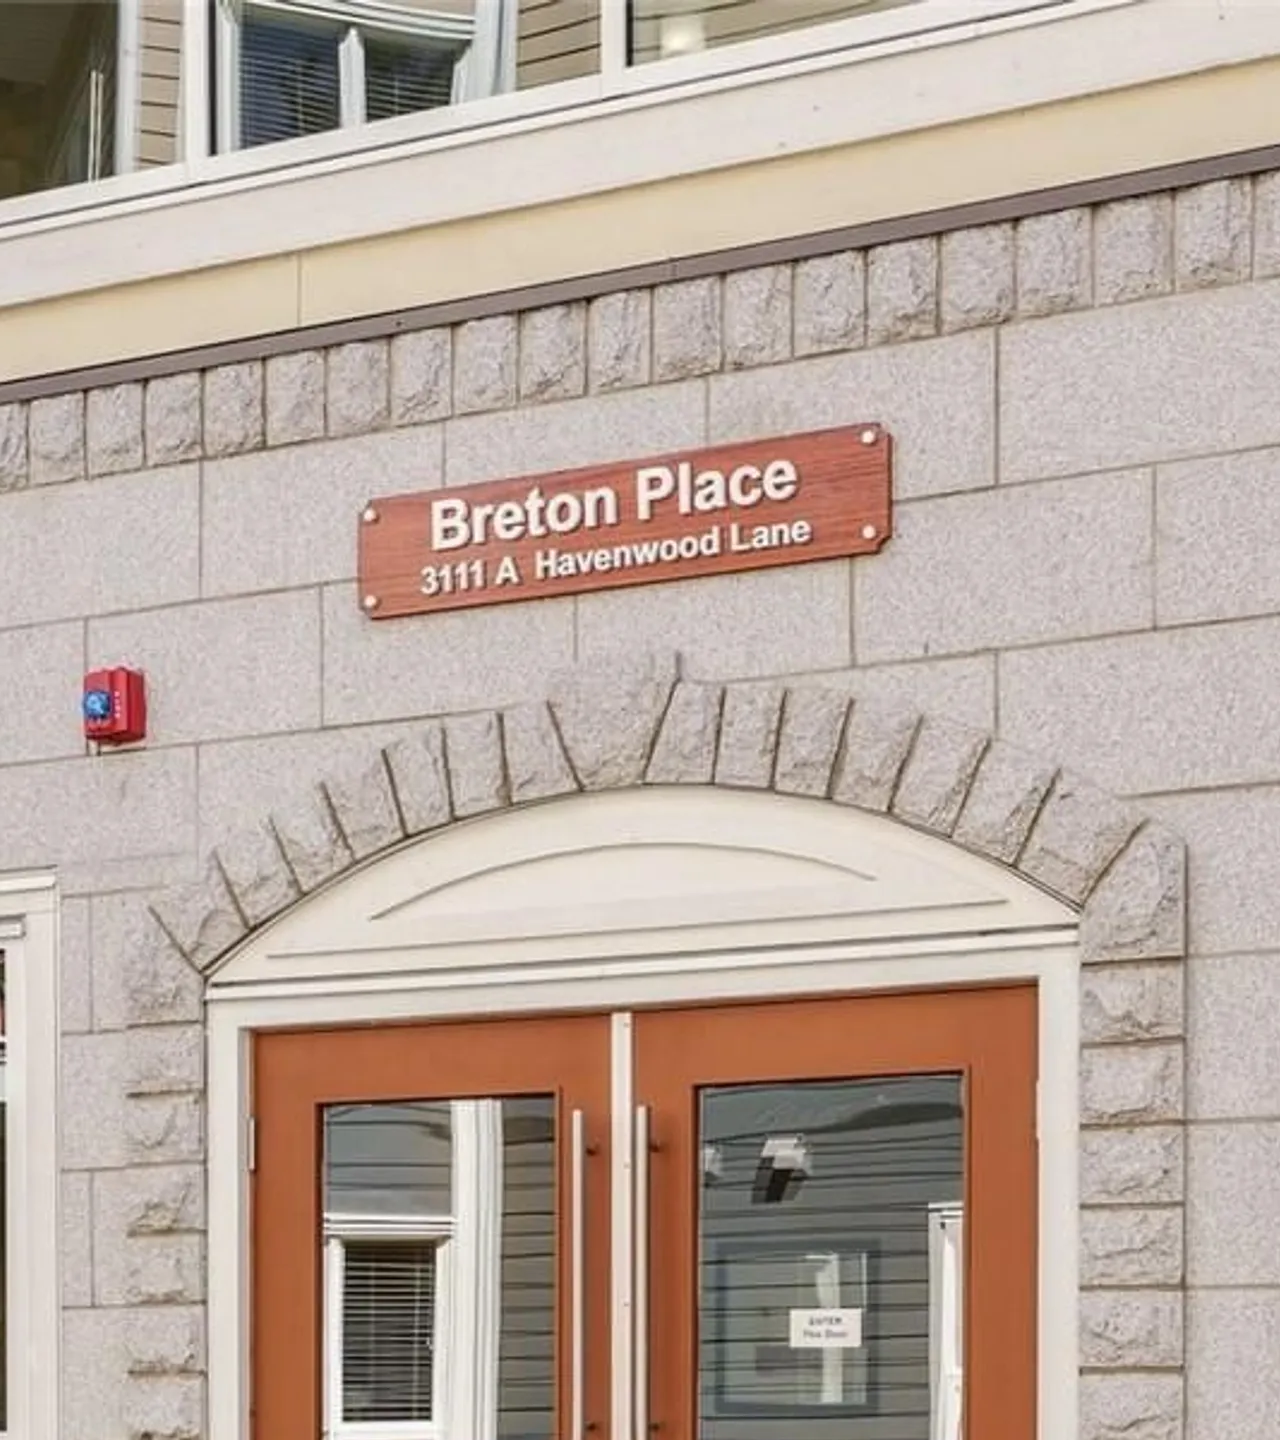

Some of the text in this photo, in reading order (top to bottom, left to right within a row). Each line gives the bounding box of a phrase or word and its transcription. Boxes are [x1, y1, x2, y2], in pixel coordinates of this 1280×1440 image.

[430, 457, 798, 552] Breton Place
[419, 517, 812, 597] 3111 A Havenwood Lane
